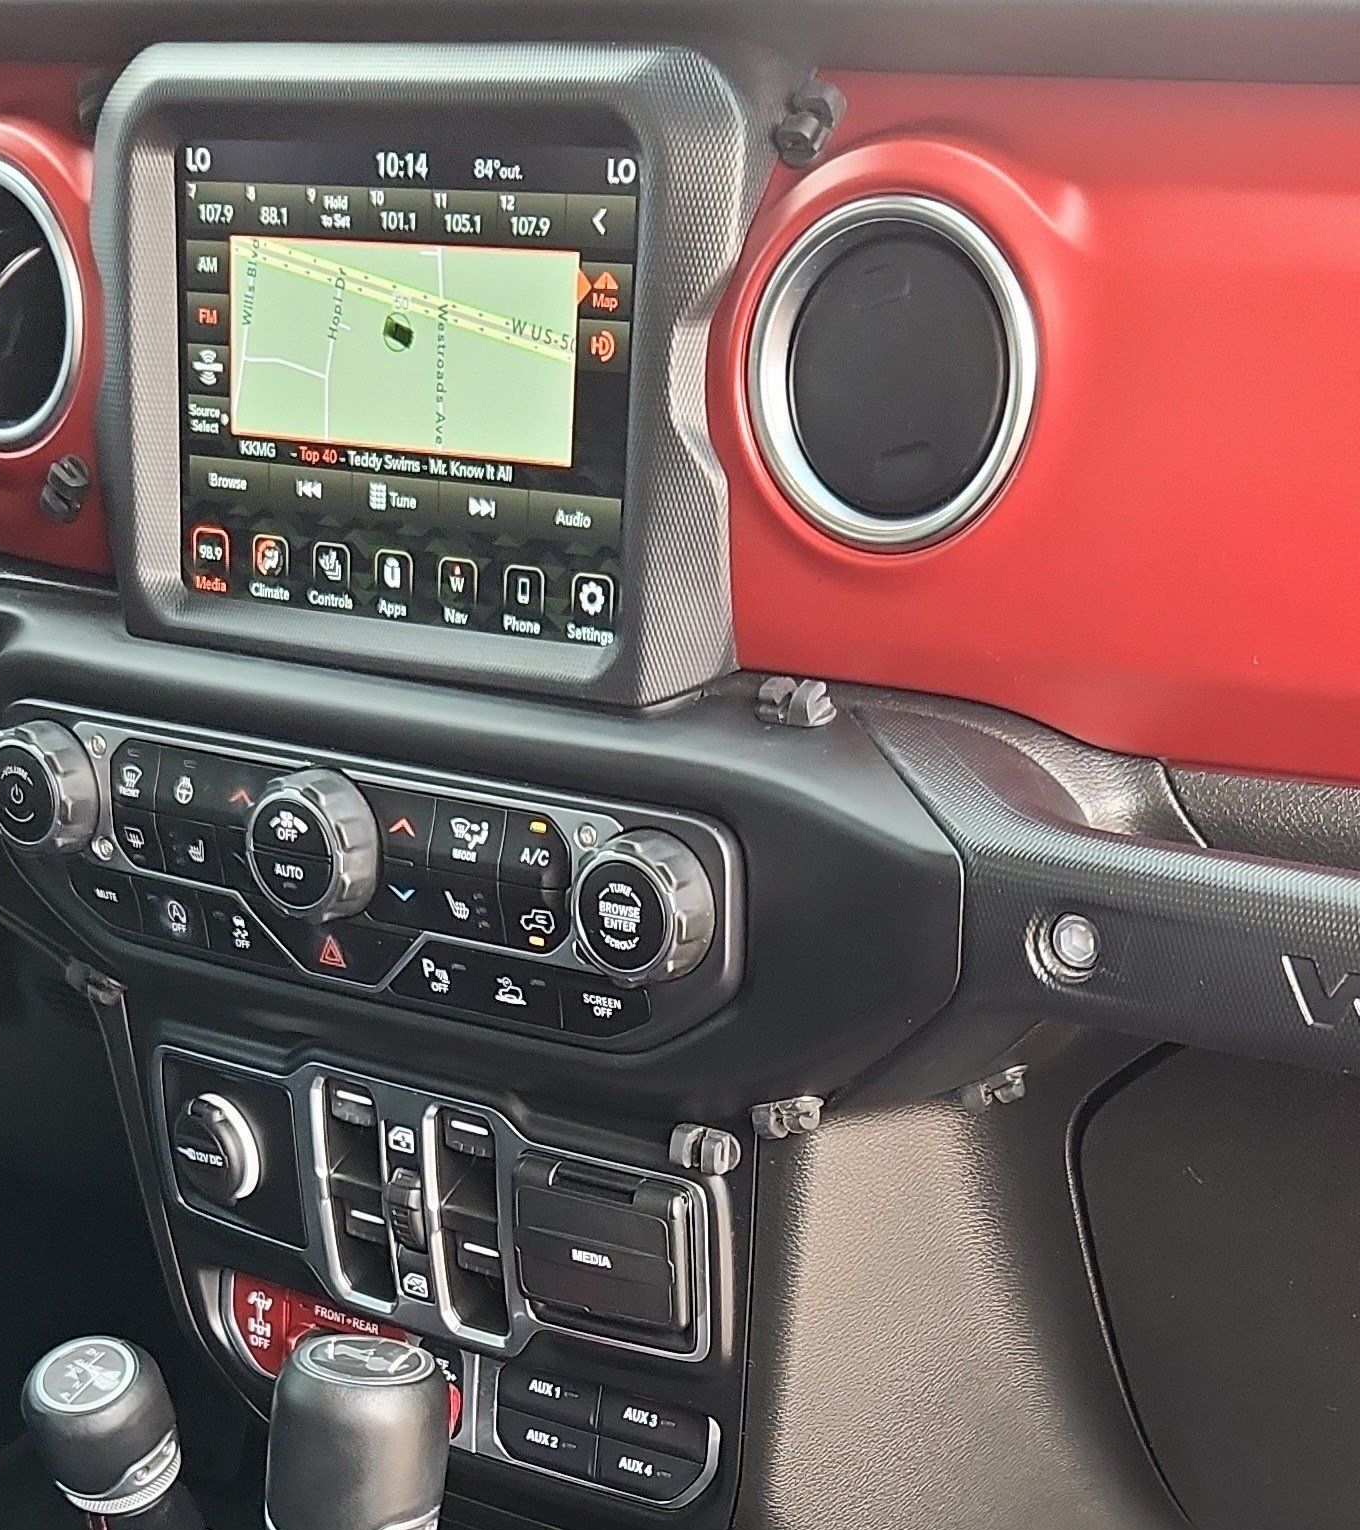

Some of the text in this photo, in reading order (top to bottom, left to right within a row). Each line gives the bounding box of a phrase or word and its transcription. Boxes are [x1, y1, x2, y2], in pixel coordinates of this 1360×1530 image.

[185, 147, 211, 172] LO
[375, 151, 429, 180] 10:14
[606, 158, 636, 184] LO
[188, 183, 197, 200] 7
[369, 189, 385, 206] 10
[433, 192, 447, 209] 11
[323, 195, 349, 211] Hold
[499, 195, 515, 211] 12
[197, 203, 234, 224] 107.9
[259, 206, 288, 226] 88.1
[380, 211, 416, 231] 101.1
[444, 214, 482, 235] 105.1
[510, 216, 551, 237] 107.9
[197, 255, 218, 273] AM
[334, 267, 347, 290] Dr
[241, 285, 256, 326] Wills
[592, 292, 619, 312] Map
[198, 308, 218, 325] FM
[511, 317, 528, 336] W
[435, 303, 449, 445] Westroads Ave
[189, 403, 220, 419] Source
[191, 420, 219, 434] Select
[240, 440, 276, 458] KKMG
[300, 446, 320, 464] Top
[322, 449, 337, 464] 40
[347, 451, 382, 471] Teddy
[384, 454, 420, 473] Swims
[449, 461, 484, 480] Know
[497, 465, 513, 482] All
[208, 473, 247, 490] Browse
[389, 492, 417, 509] Tune
[555, 509, 591, 528] Audio
[199, 545, 222, 561] 98.9
[195, 576, 227, 592] Media
[252, 583, 290, 601] Climate
[309, 590, 353, 609] Controls
[378, 599, 407, 618] Apps
[443, 607, 468, 624] Nav
[503, 614, 540, 634] Phone
[566, 623, 614, 646] Settings
[276, 827, 298, 842] OFF
[452, 848, 477, 863] MODE
[520, 847, 550, 867] A/C
[275, 862, 304, 880] AUTO
[95, 888, 118, 903] MUTE
[608, 882, 632, 897] TUNE
[599, 900, 641, 919] BROWSE
[171, 922, 187, 933] OFF
[604, 918, 637, 934] ENTER
[235, 937, 251, 949] OFF
[430, 981, 450, 994] OFF
[582, 993, 622, 1010] SCREEN
[593, 1006, 613, 1018] OFF
[210, 1154, 223, 1167] DC
[572, 1249, 612, 1269] MEDIA
[249, 1334, 271, 1349] OFF
[529, 1379, 561, 1399] AUX 1
[623, 1406, 658, 1428] AUX 3
[526, 1428, 559, 1449] AUX 2
[618, 1456, 653, 1477] AUX 4
